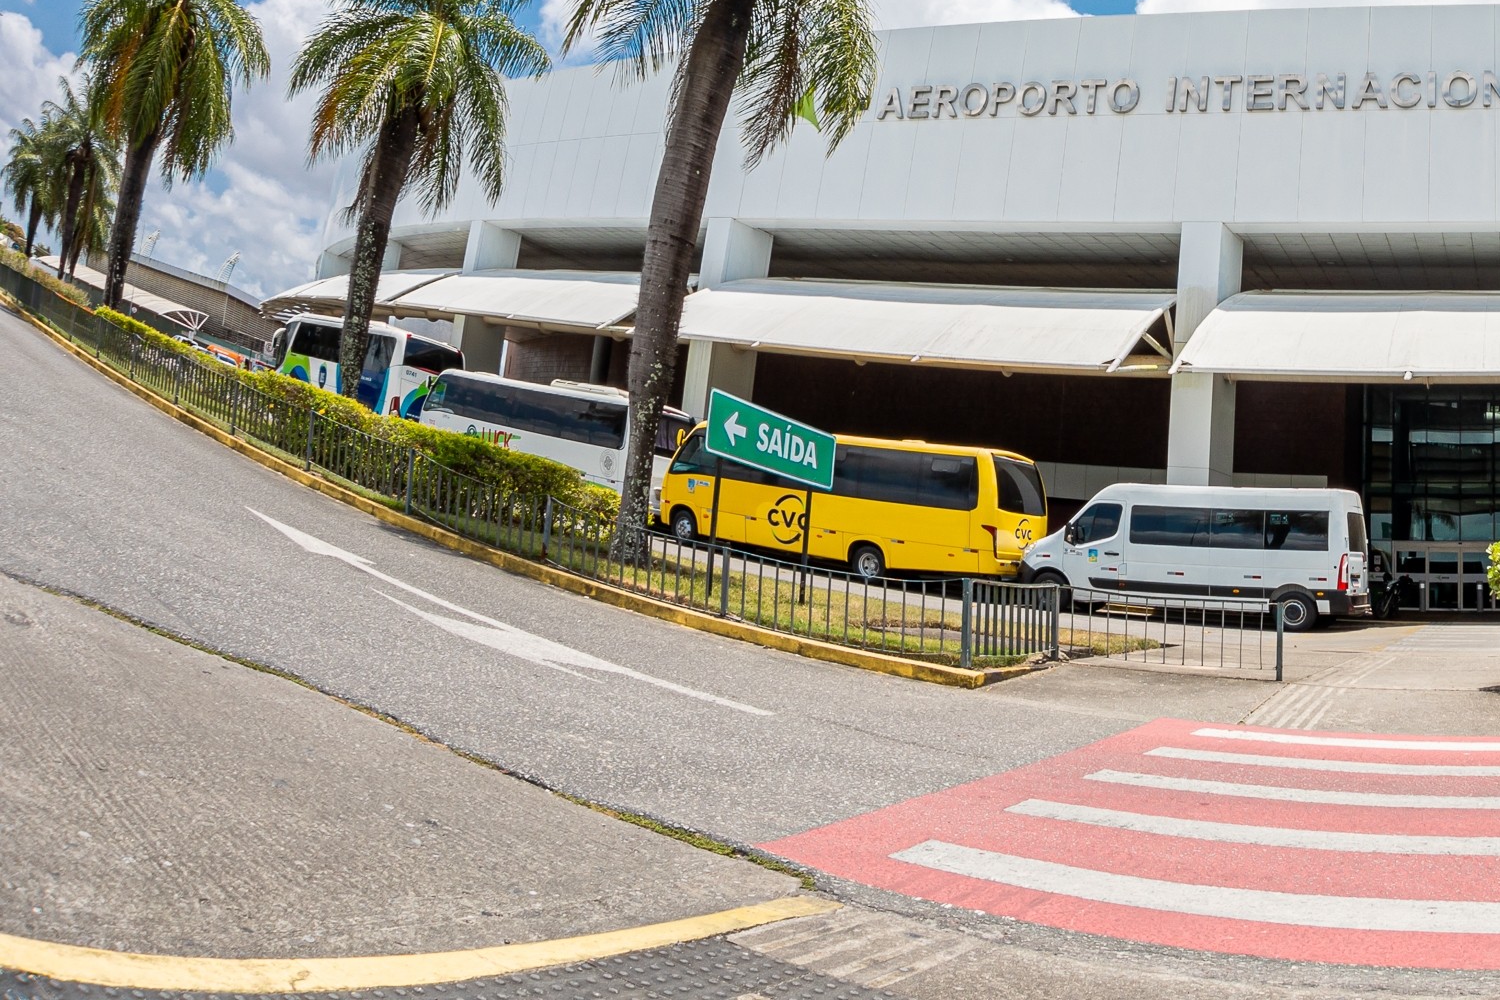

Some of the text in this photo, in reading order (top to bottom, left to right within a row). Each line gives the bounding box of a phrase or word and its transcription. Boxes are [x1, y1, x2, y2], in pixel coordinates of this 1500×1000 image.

[877, 77, 1140, 120] AEROPORTO
[756, 423, 817, 470] SAÍDA
[1015, 528, 1032, 540] CVC
